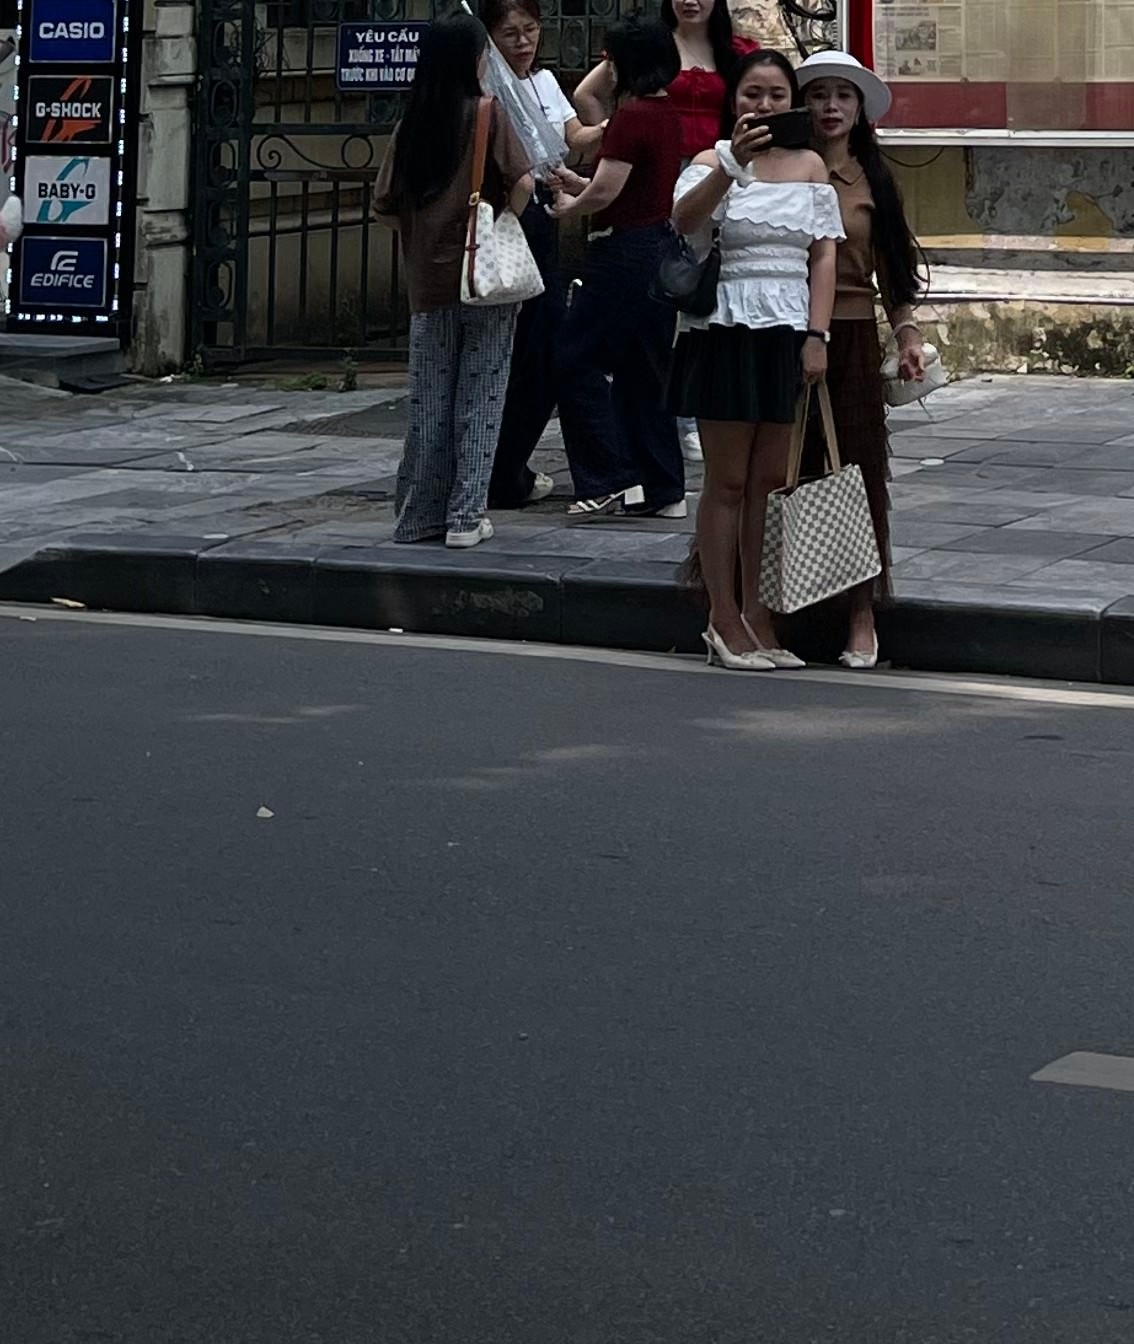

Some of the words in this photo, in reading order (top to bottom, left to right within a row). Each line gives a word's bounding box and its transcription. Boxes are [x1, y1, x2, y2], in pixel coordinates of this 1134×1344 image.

[39, 21, 105, 40] CASIO
[355, 28, 385, 43] YÊU
[36, 102, 102, 118] G-SHOCK
[38, 183, 96, 200] BABY-G
[30, 273, 95, 289] EDIFICE
